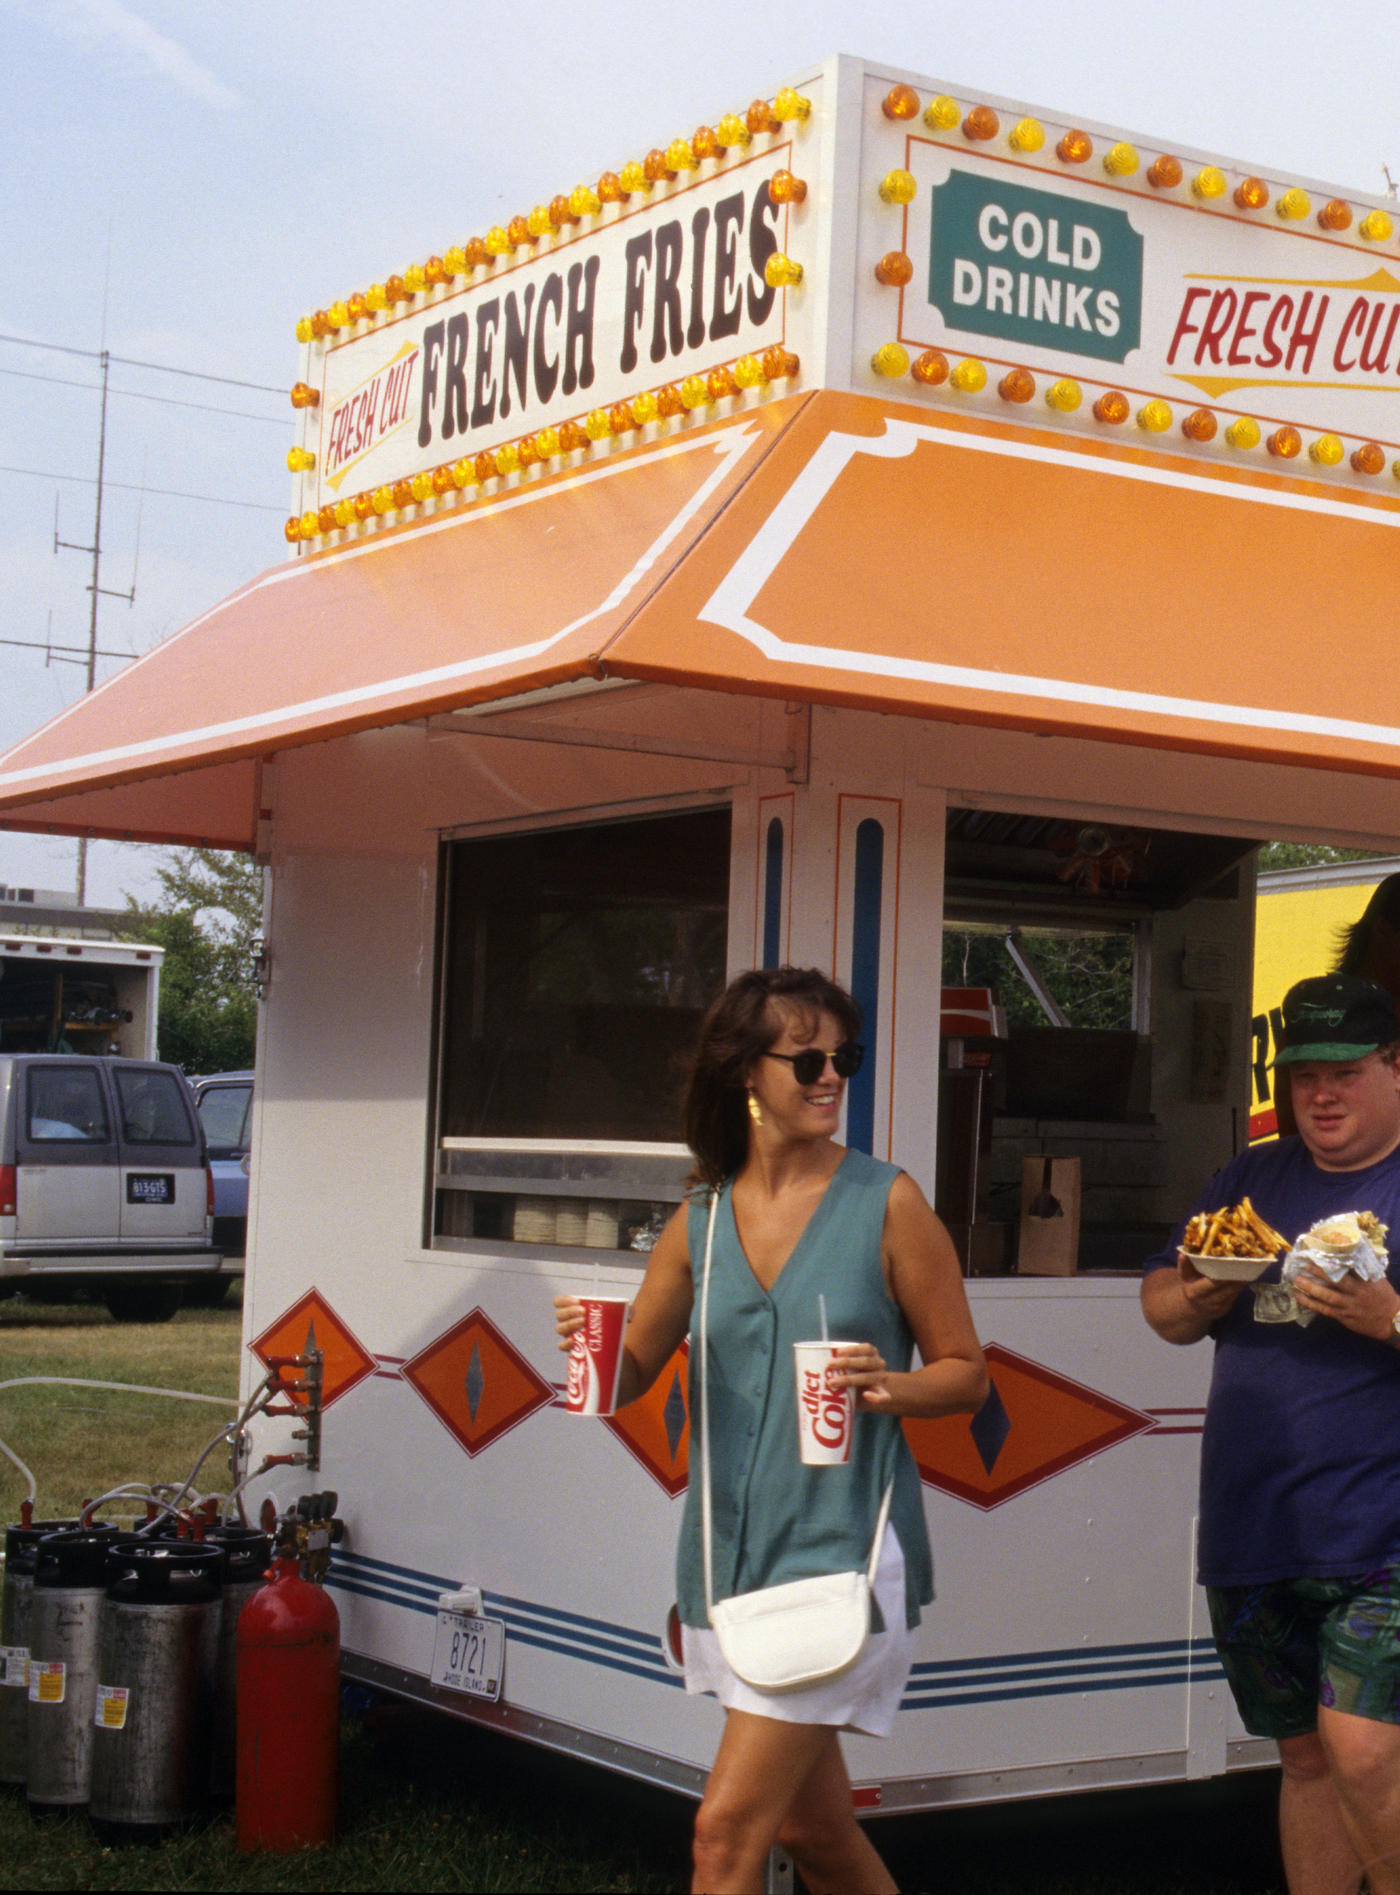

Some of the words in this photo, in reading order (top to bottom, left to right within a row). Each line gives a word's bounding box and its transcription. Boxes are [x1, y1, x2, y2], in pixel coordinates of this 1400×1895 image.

[977, 203, 1102, 272] COLD
[418, 255, 600, 448] FRENCH
[621, 178, 780, 374] FRIES
[952, 258, 1121, 337] DRINKS
[1166, 287, 1330, 375] FRESH
[324, 388, 378, 477] FRESH
[379, 349, 419, 435] CUT
[588, 1303, 602, 1352] CLASSIC
[802, 1370, 820, 1415] diet
[451, 1631, 486, 1676] 8721
